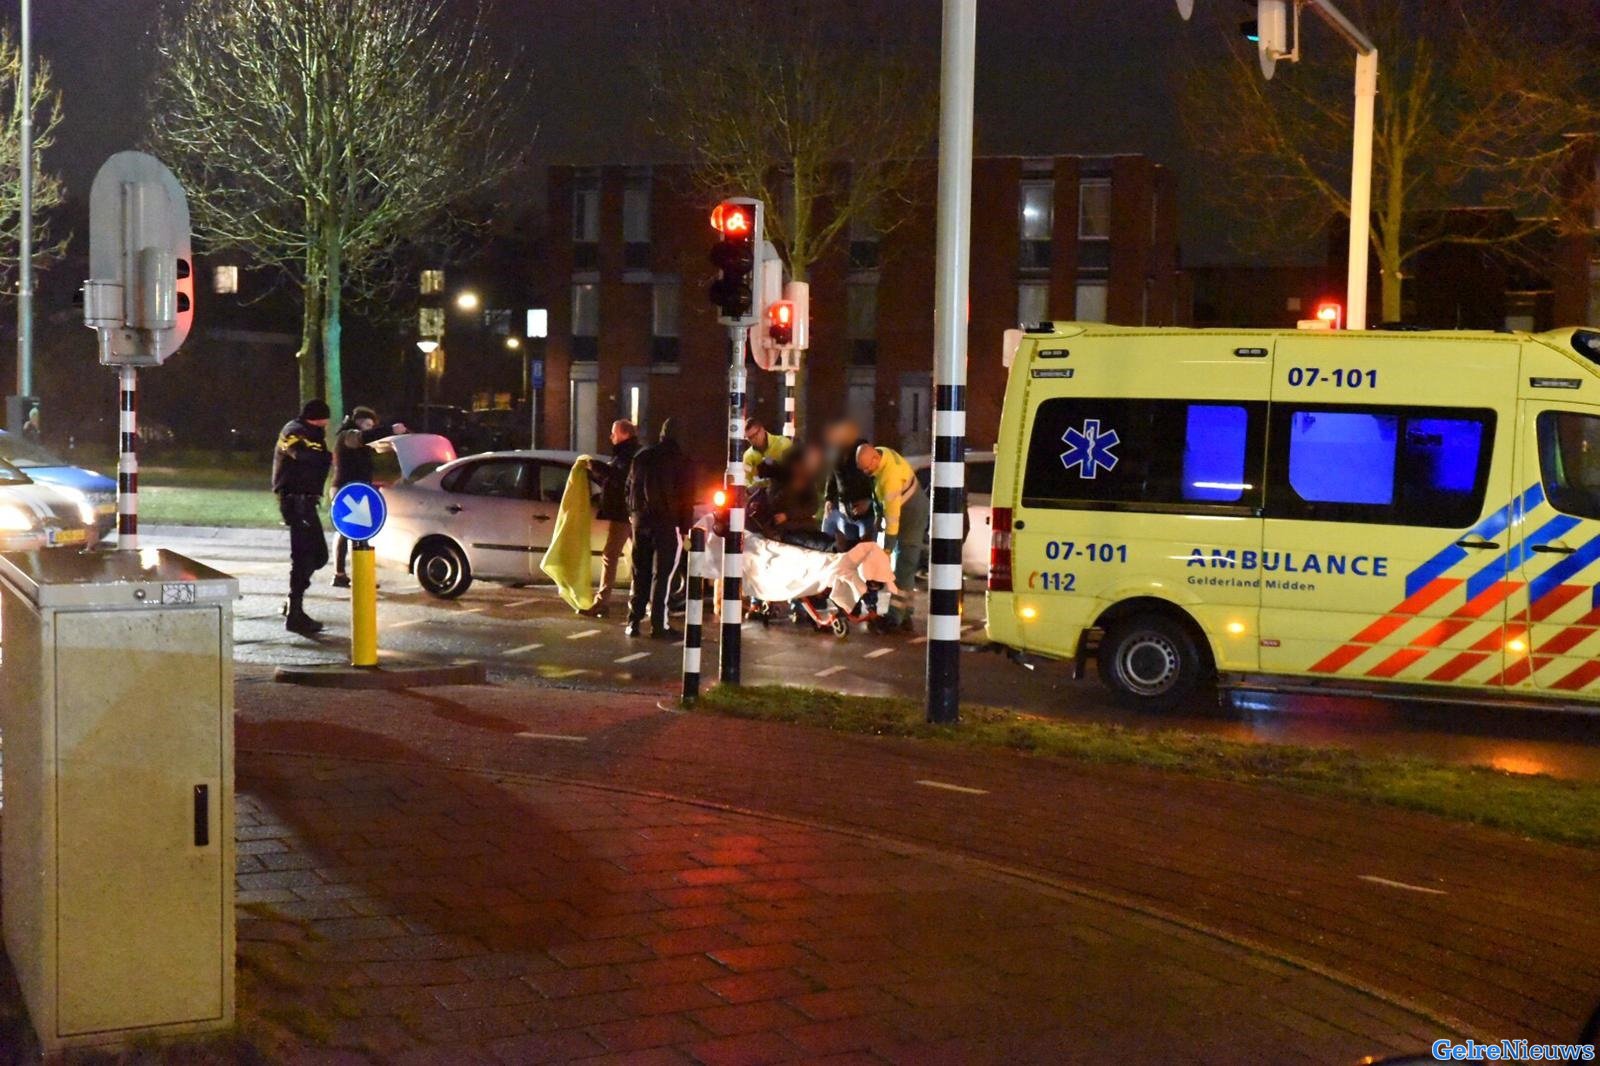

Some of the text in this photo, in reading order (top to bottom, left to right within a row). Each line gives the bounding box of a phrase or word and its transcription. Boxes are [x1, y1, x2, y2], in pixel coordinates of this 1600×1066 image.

[1287, 367, 1377, 389] 07-101
[1045, 541, 1127, 563] 07-101
[1186, 548, 1389, 577] AMBULANCE
[1187, 575, 1316, 592] Gelderland Midden
